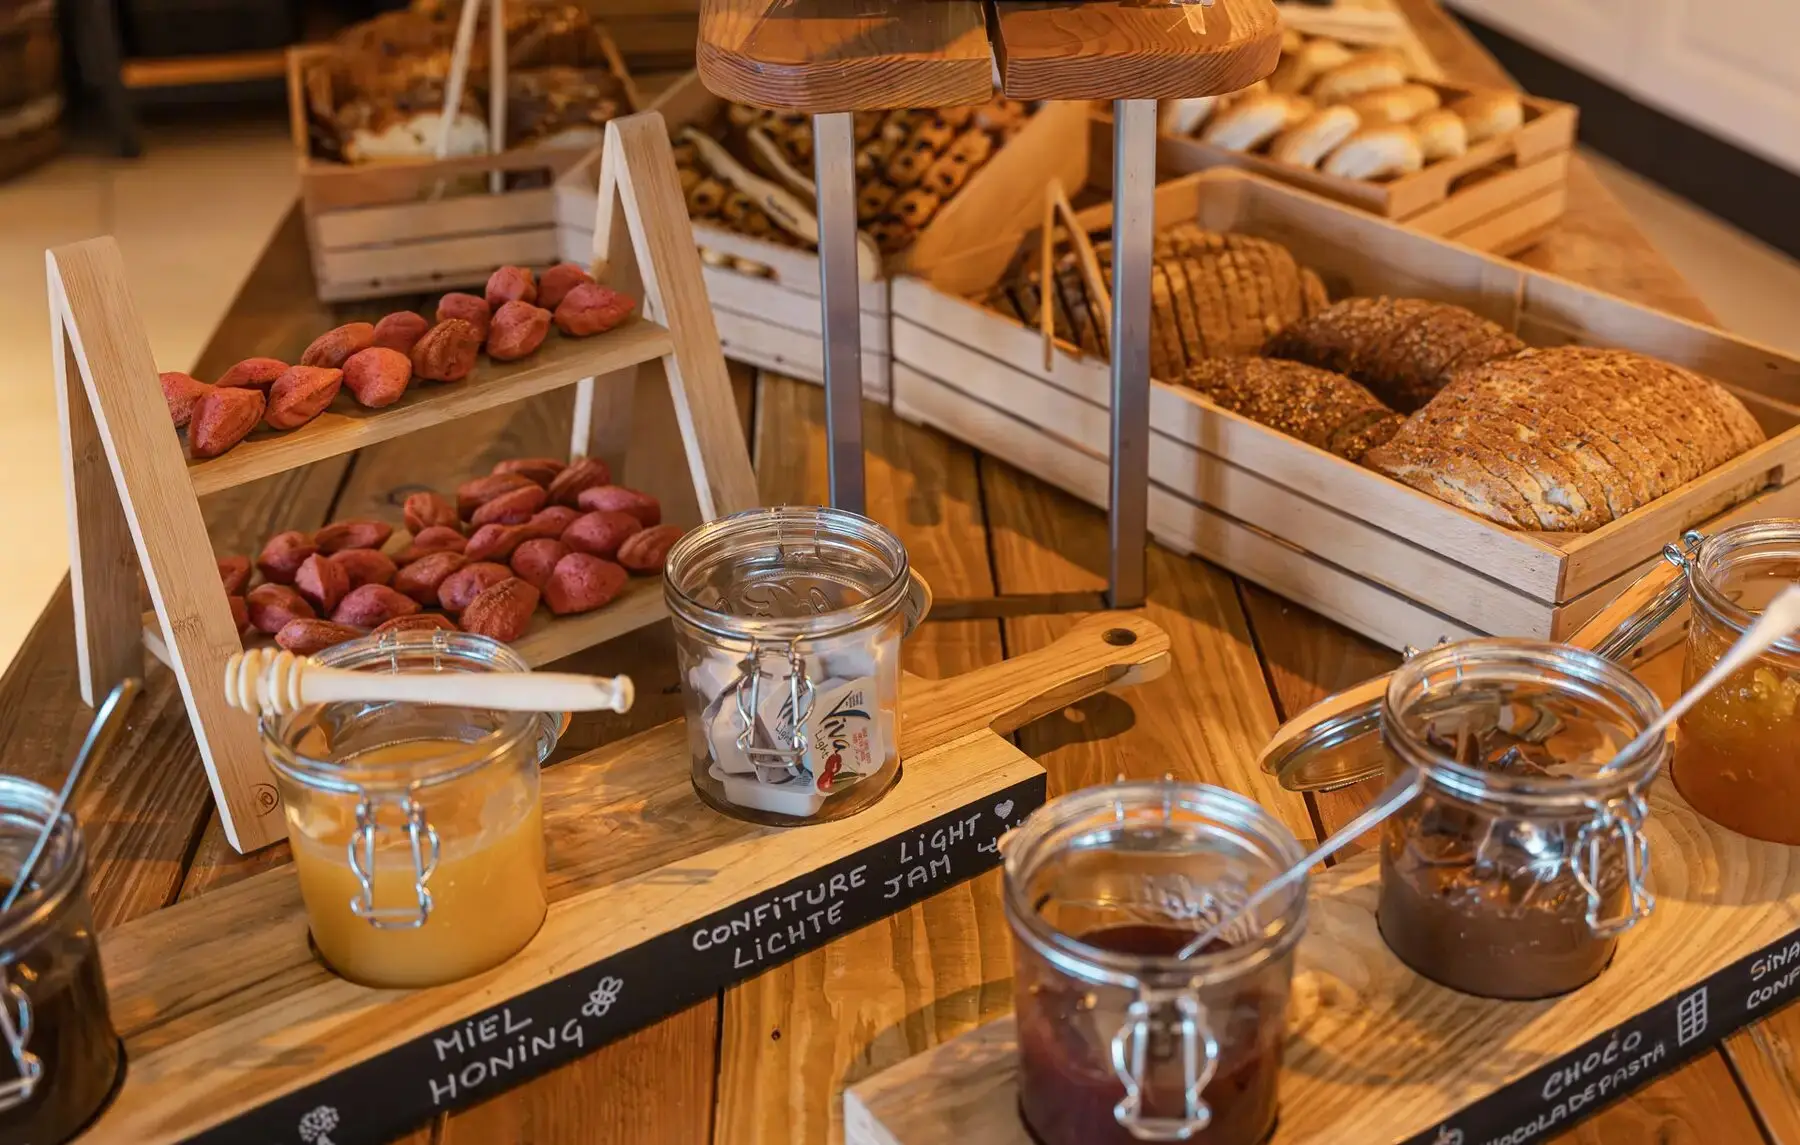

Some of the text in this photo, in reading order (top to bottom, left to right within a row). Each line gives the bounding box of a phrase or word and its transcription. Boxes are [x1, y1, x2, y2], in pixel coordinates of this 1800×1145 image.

[814, 729, 830, 760] Light
[818, 690, 871, 755] Viva
[692, 812, 981, 951] CONFiTURE LiGHT
[733, 854, 951, 969] LiCHTE JAM
[428, 1018, 584, 1104] HONiNG
[433, 1008, 533, 1061] MiEL
[1480, 1041, 1665, 1145] OCOLADEPASTA
